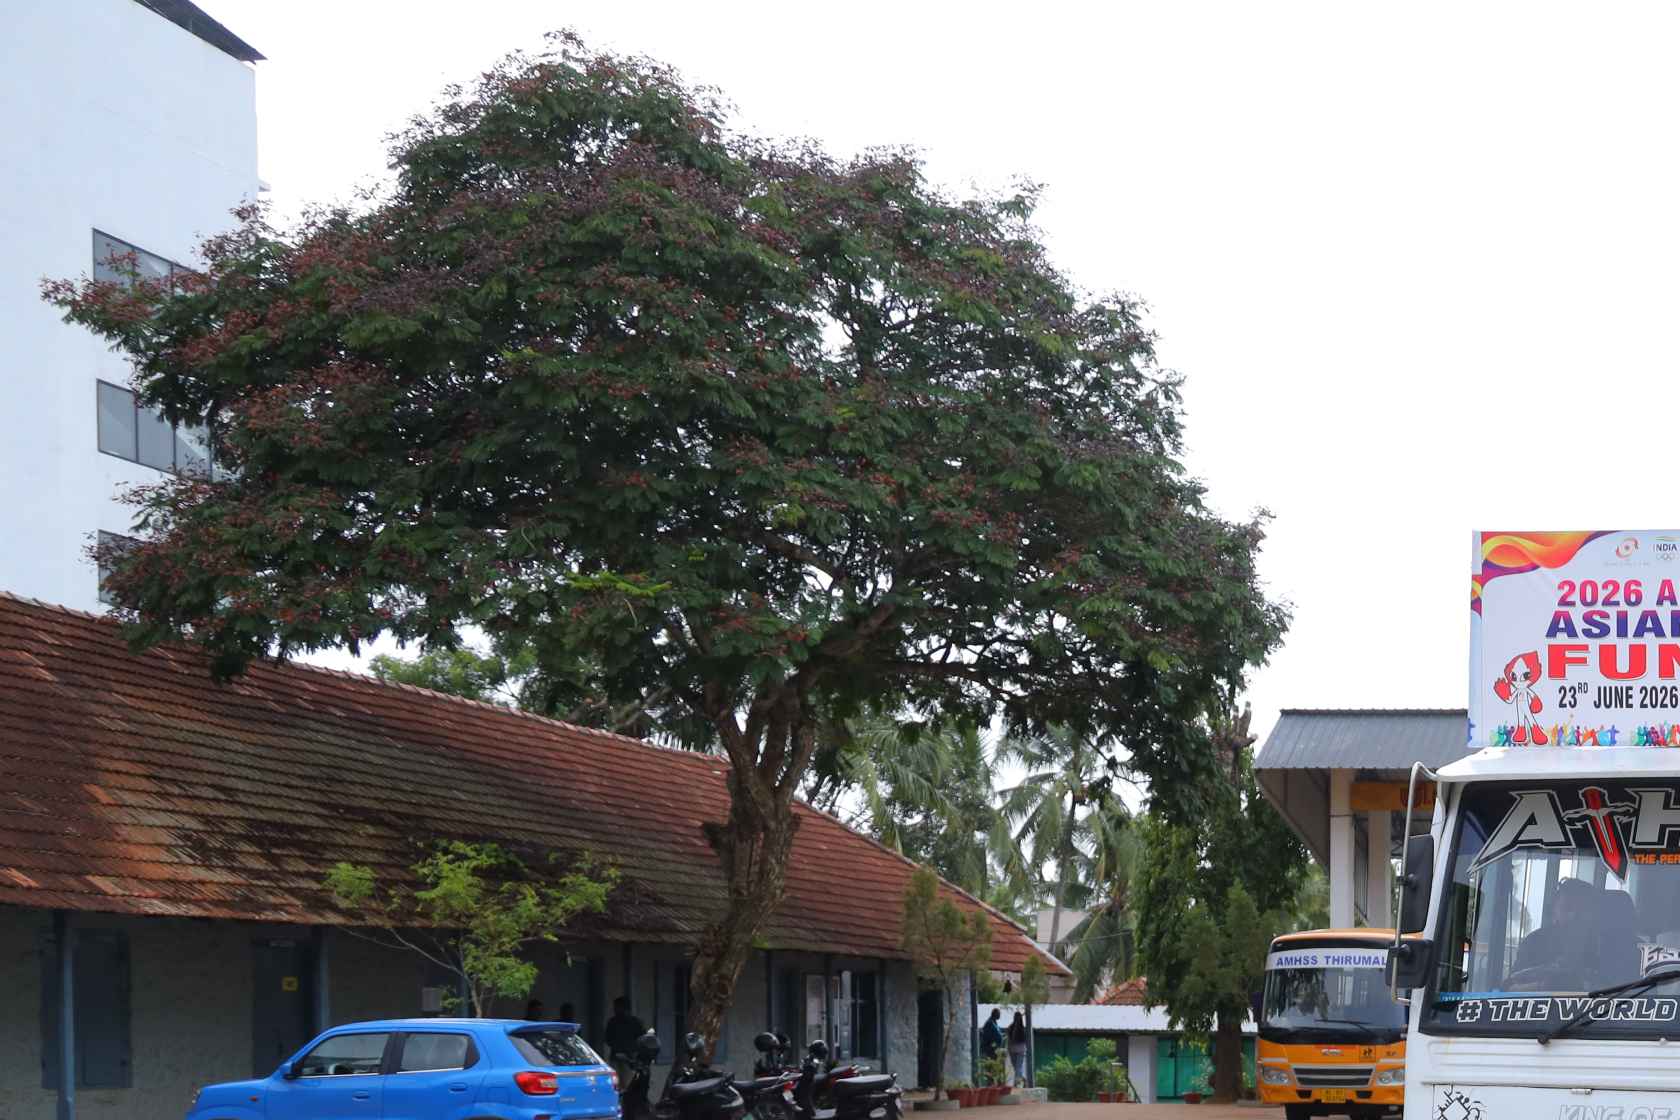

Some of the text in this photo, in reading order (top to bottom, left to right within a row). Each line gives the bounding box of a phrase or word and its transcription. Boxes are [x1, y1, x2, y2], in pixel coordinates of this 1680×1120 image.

[1557, 579, 1643, 607] 2026
[1593, 685, 1634, 708] JUNE
[1639, 685, 1679, 708] 2026
[1634, 853, 1657, 864] THE
[1276, 955, 1387, 966] AMHSS THIRUMAL
[1488, 998, 1551, 1021] THE
[1556, 998, 1678, 1022] WORLD
